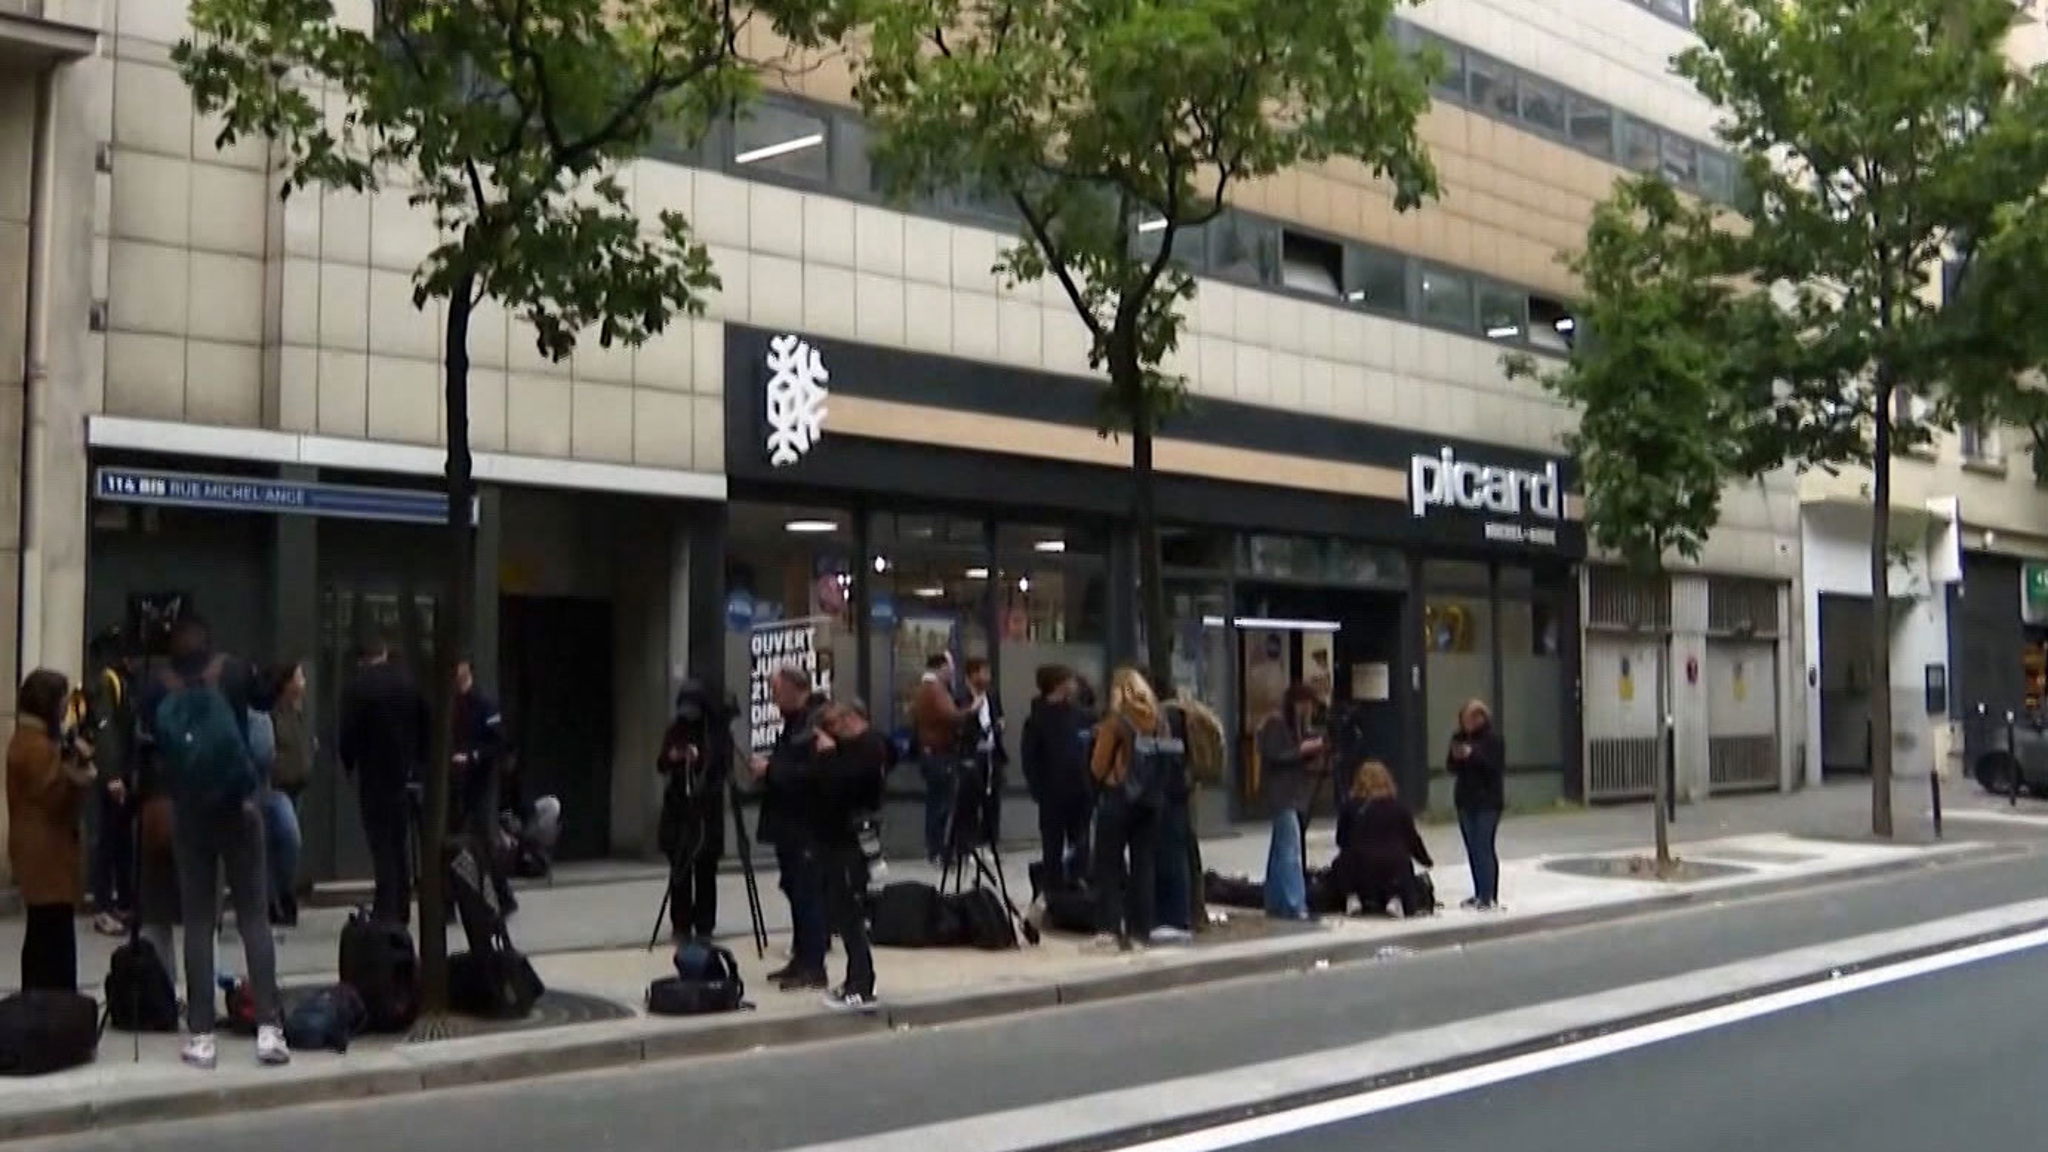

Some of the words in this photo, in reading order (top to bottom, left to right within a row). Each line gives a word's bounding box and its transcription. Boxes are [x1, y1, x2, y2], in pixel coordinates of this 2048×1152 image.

[108, 475, 135, 494] 114
[138, 478, 166, 496] BIS
[169, 480, 201, 499] RUE
[1411, 444, 1559, 519] picard
[752, 628, 815, 655] OUVERT
